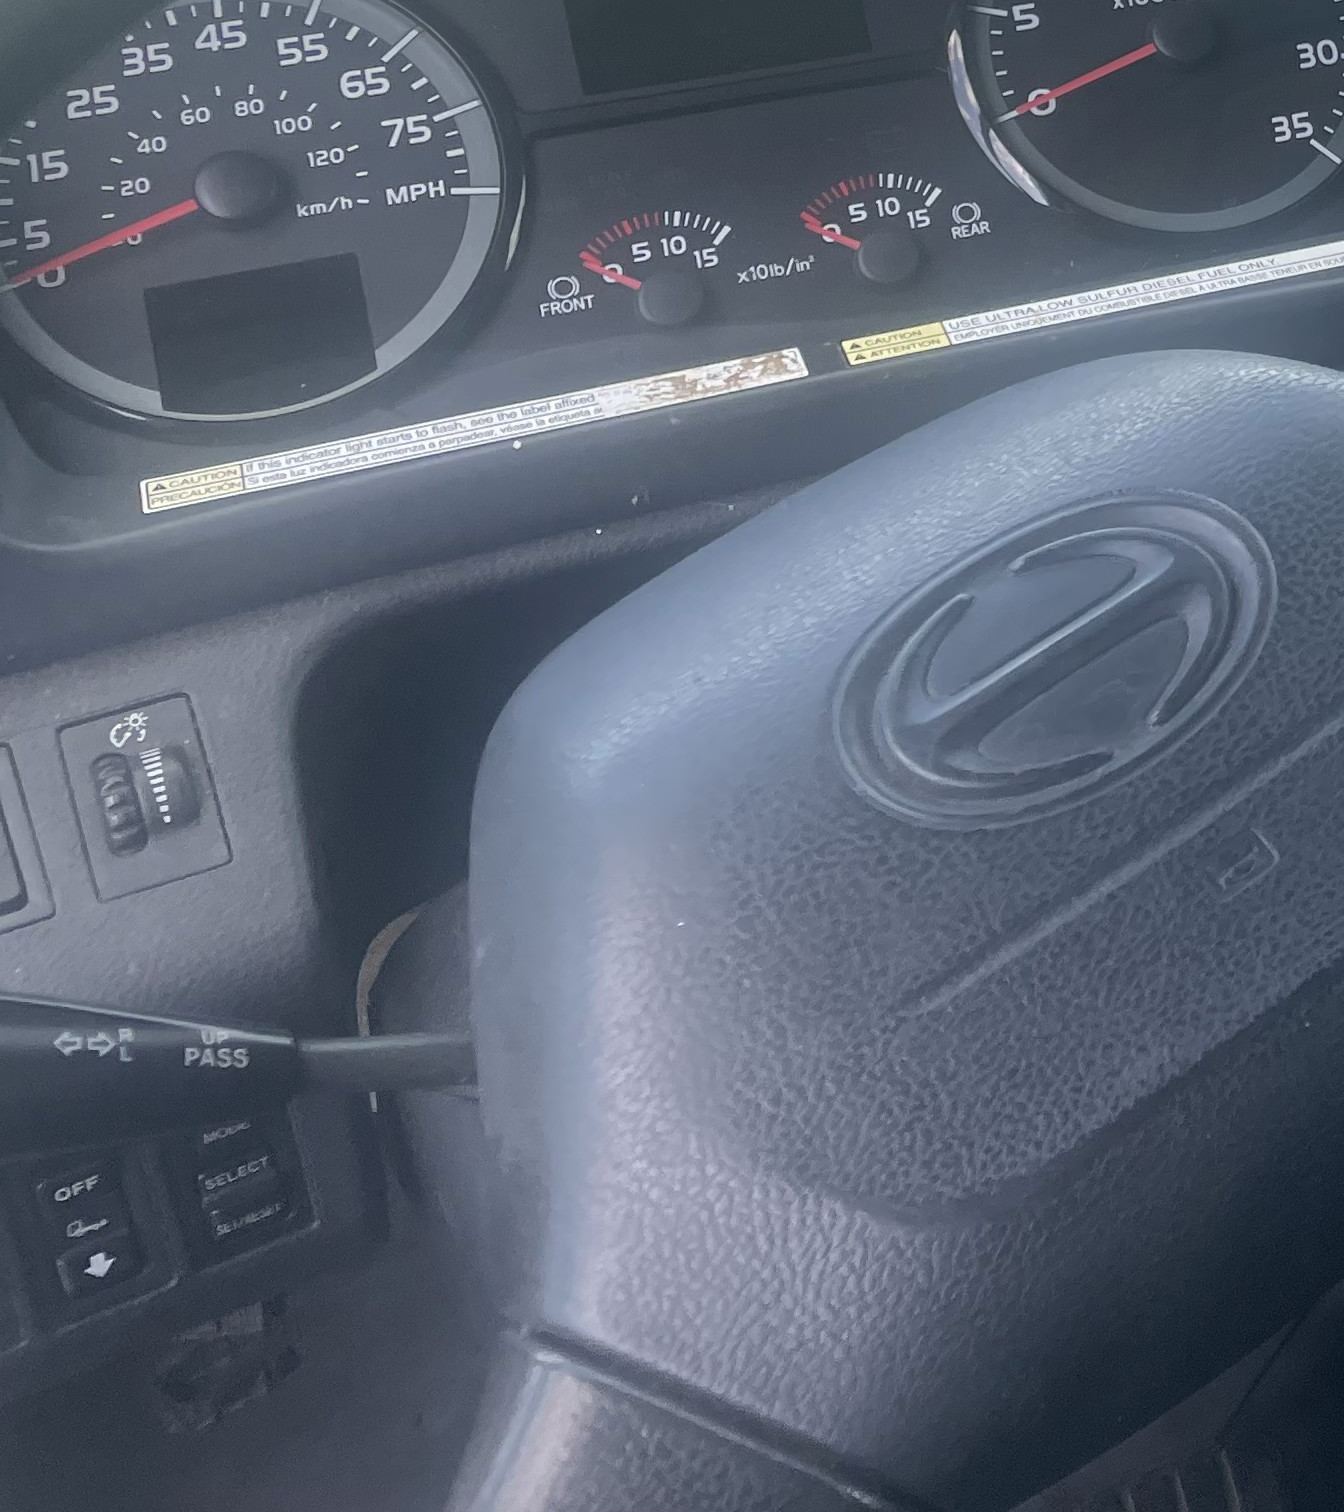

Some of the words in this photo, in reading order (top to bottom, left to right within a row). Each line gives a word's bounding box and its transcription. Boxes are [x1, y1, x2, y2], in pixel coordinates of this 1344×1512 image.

[1012, 3, 1040, 31] 5
[195, 19, 248, 52] 45
[121, 42, 174, 76] 35
[277, 33, 329, 66] 55
[1296, 39, 1339, 69] 30
[339, 65, 391, 98] 65
[66, 84, 120, 120] 25
[234, 97, 264, 117] 80
[1027, 88, 1058, 117] 0
[180, 105, 211, 125] 60
[272, 114, 313, 136] 100
[1271, 111, 1314, 143] 35
[380, 113, 433, 148] 75
[136, 135, 167, 155] 40
[27, 150, 69, 184] 15
[306, 146, 346, 169] 120
[119, 176, 151, 197] 20
[385, 179, 446, 207] MPH
[295, 194, 354, 217] km/h
[848, 201, 869, 223] 5
[875, 196, 902, 220] 10
[907, 207, 932, 230] 15
[950, 219, 991, 240] REAR
[24, 219, 51, 251] 5
[660, 235, 687, 257] 10
[631, 241, 652, 263] 5
[693, 247, 719, 269] 15
[539, 293, 595, 317] FRONT
[948, 315, 983, 331] USE
[1077, 284, 1139, 305] SULFUR
[1141, 273, 1198, 292] DIESEL
[1199, 266, 1237, 281] FUEL
[864, 329, 923, 348] CAUTION
[869, 338, 941, 360] ATTENTION
[258, 459, 282, 470] this
[285, 447, 343, 466] indicator
[345, 439, 373, 453] light
[376, 433, 413, 447] starts
[416, 428, 429, 438] to
[497, 410, 518, 421] the
[520, 403, 552, 417] label
[554, 393, 596, 410] affixed
[169, 467, 238, 489] CAUTION
[150, 479, 242, 506] PRECAUCIÓN
[201, 1030, 230, 1045] UP
[184, 1047, 250, 1069] PASS
[204, 1156, 270, 1190] SELECT
[54, 1174, 101, 1202] OFF
